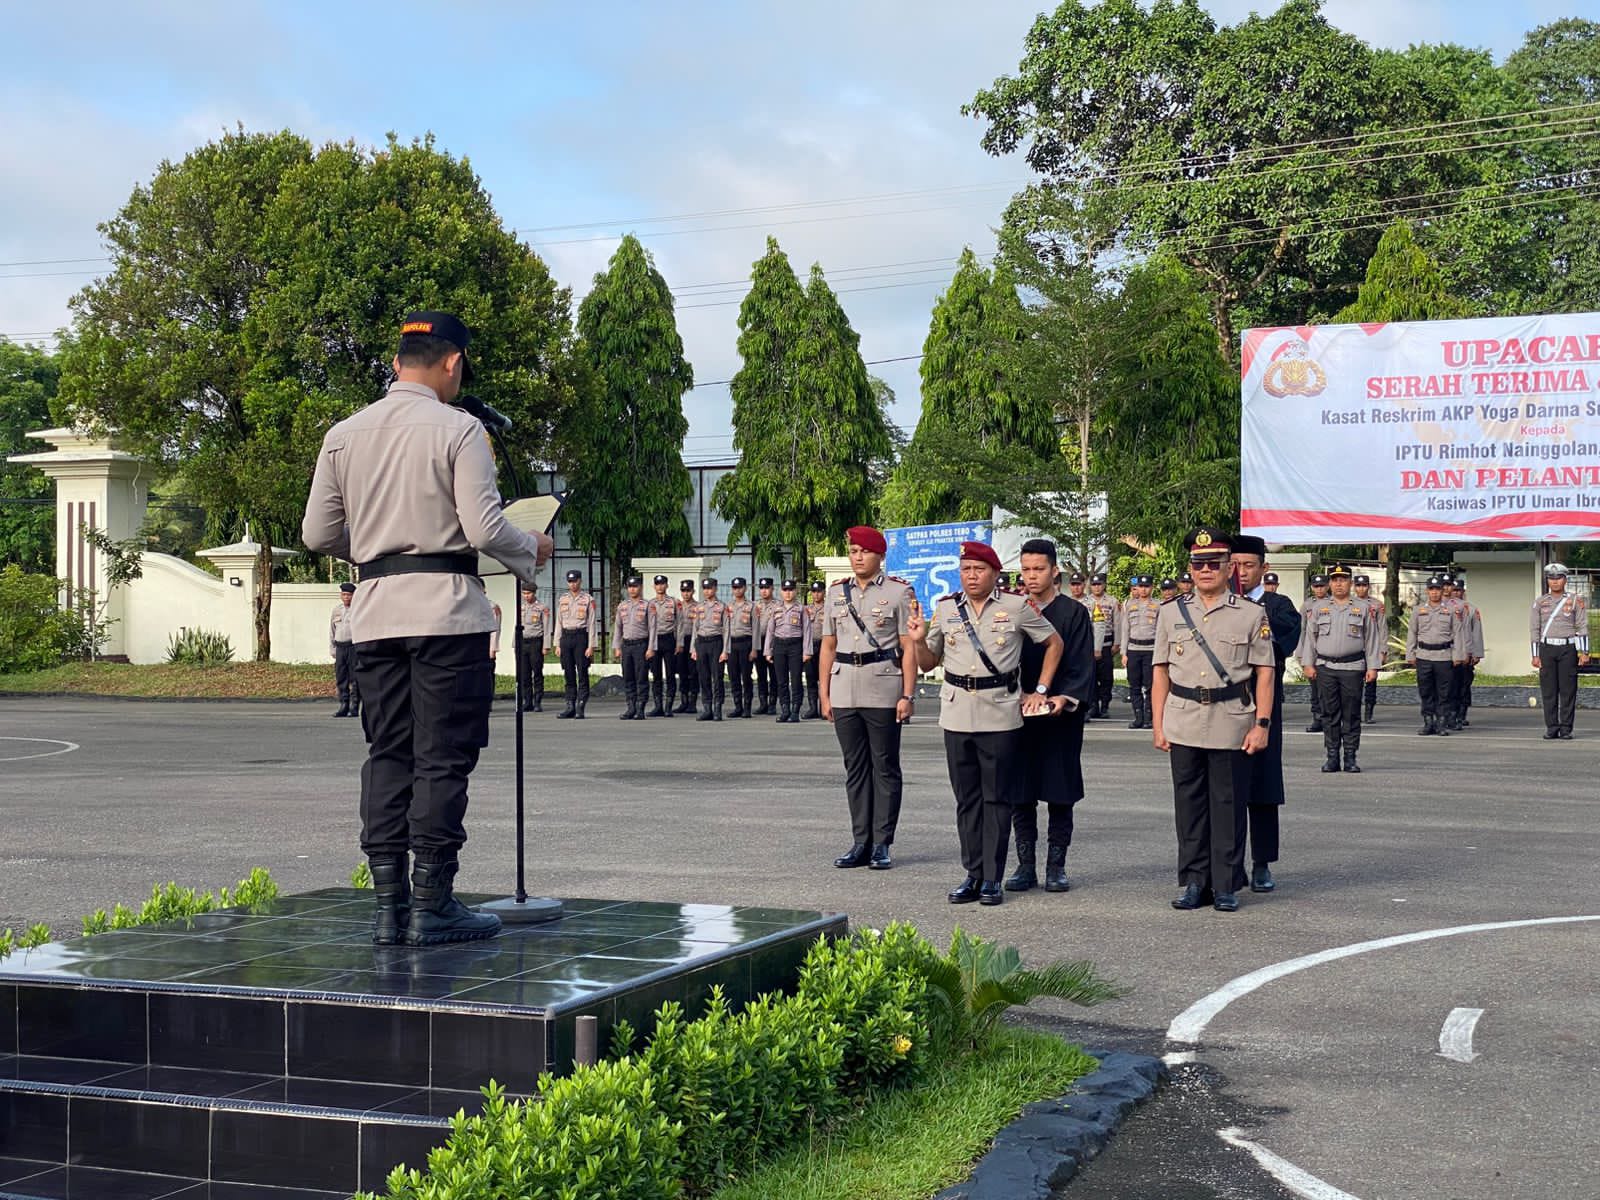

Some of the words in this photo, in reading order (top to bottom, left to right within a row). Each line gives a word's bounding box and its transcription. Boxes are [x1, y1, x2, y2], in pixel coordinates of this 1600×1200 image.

[1366, 374, 1463, 399] SERAH
[1471, 369, 1590, 394] TERIMA
[1321, 408, 1366, 425] Kasat
[1371, 407, 1436, 423] Reskrim
[1441, 405, 1474, 421] AKP
[1480, 404, 1519, 422] Yoga
[1525, 403, 1580, 418] Darma
[1520, 423, 1565, 437] Kepada
[1395, 444, 1433, 461] IPTU
[1439, 443, 1497, 459] Rimhot
[1400, 469, 1465, 490] DAN
[1475, 465, 1600, 488] PELANT
[1427, 496, 1487, 511] Kasiwas
[1492, 495, 1526, 509] IPTU
[1532, 494, 1571, 508] Umar
